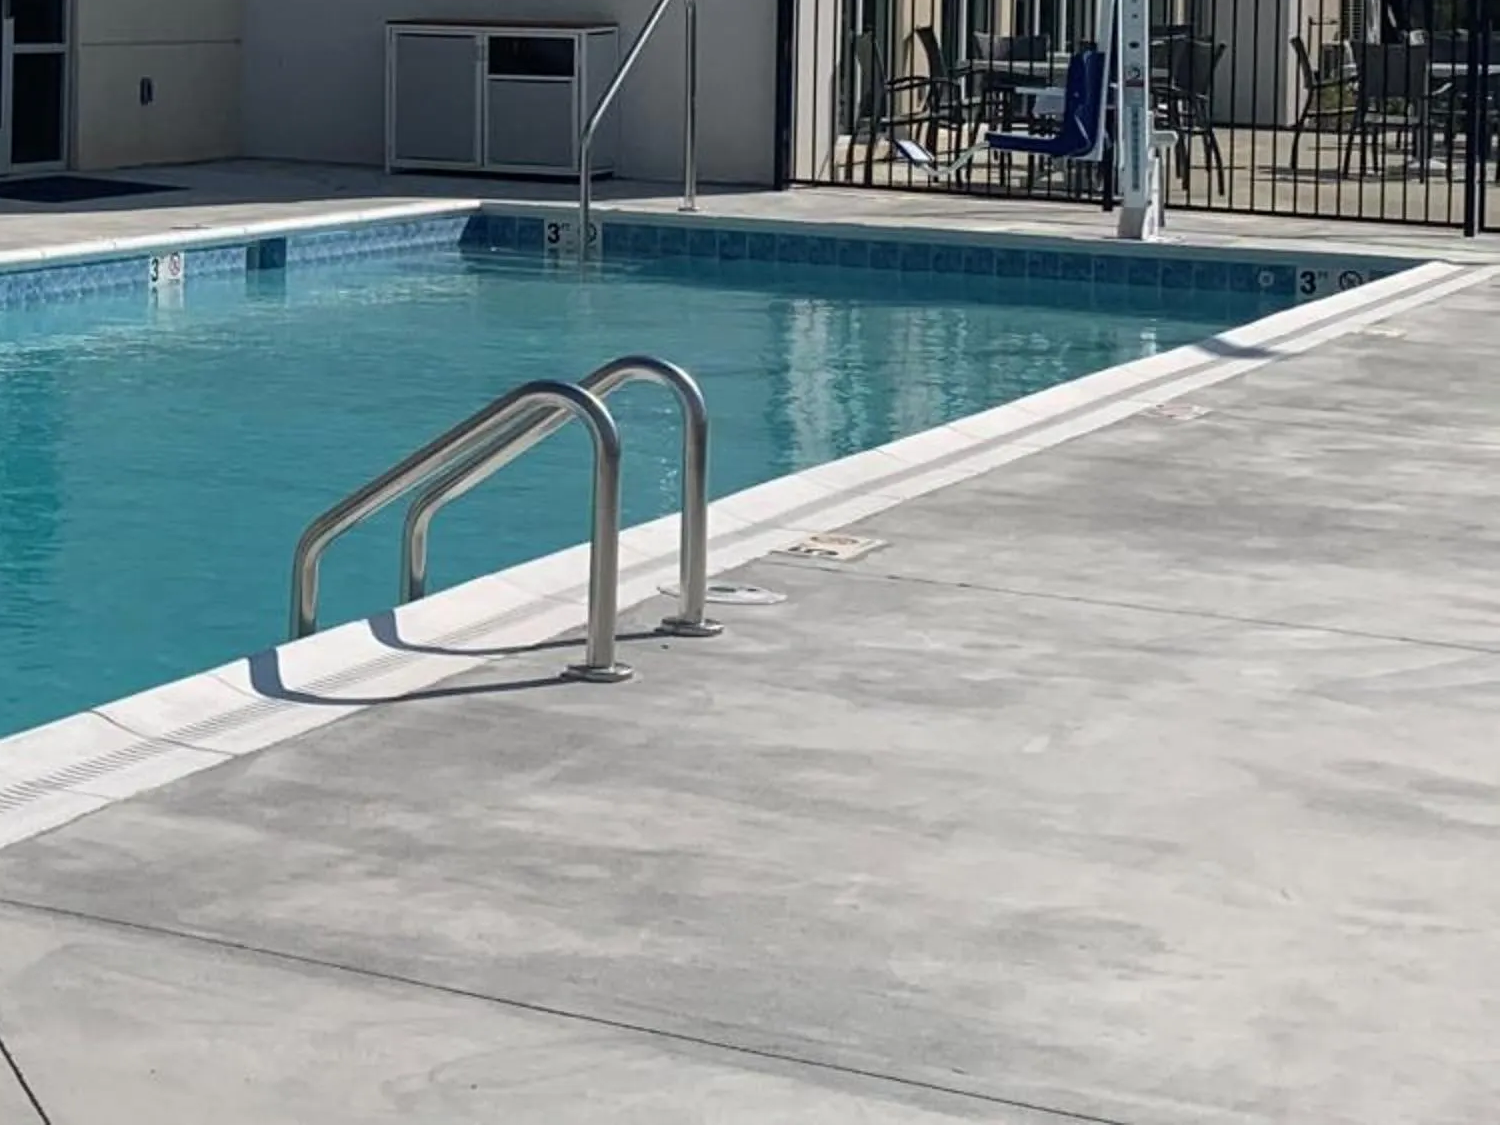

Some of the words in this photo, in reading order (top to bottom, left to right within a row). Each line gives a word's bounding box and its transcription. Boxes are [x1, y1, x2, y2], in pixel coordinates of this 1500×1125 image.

[547, 222, 560, 244] 3
[151, 257, 159, 282] 3
[1299, 271, 1317, 294] 3
